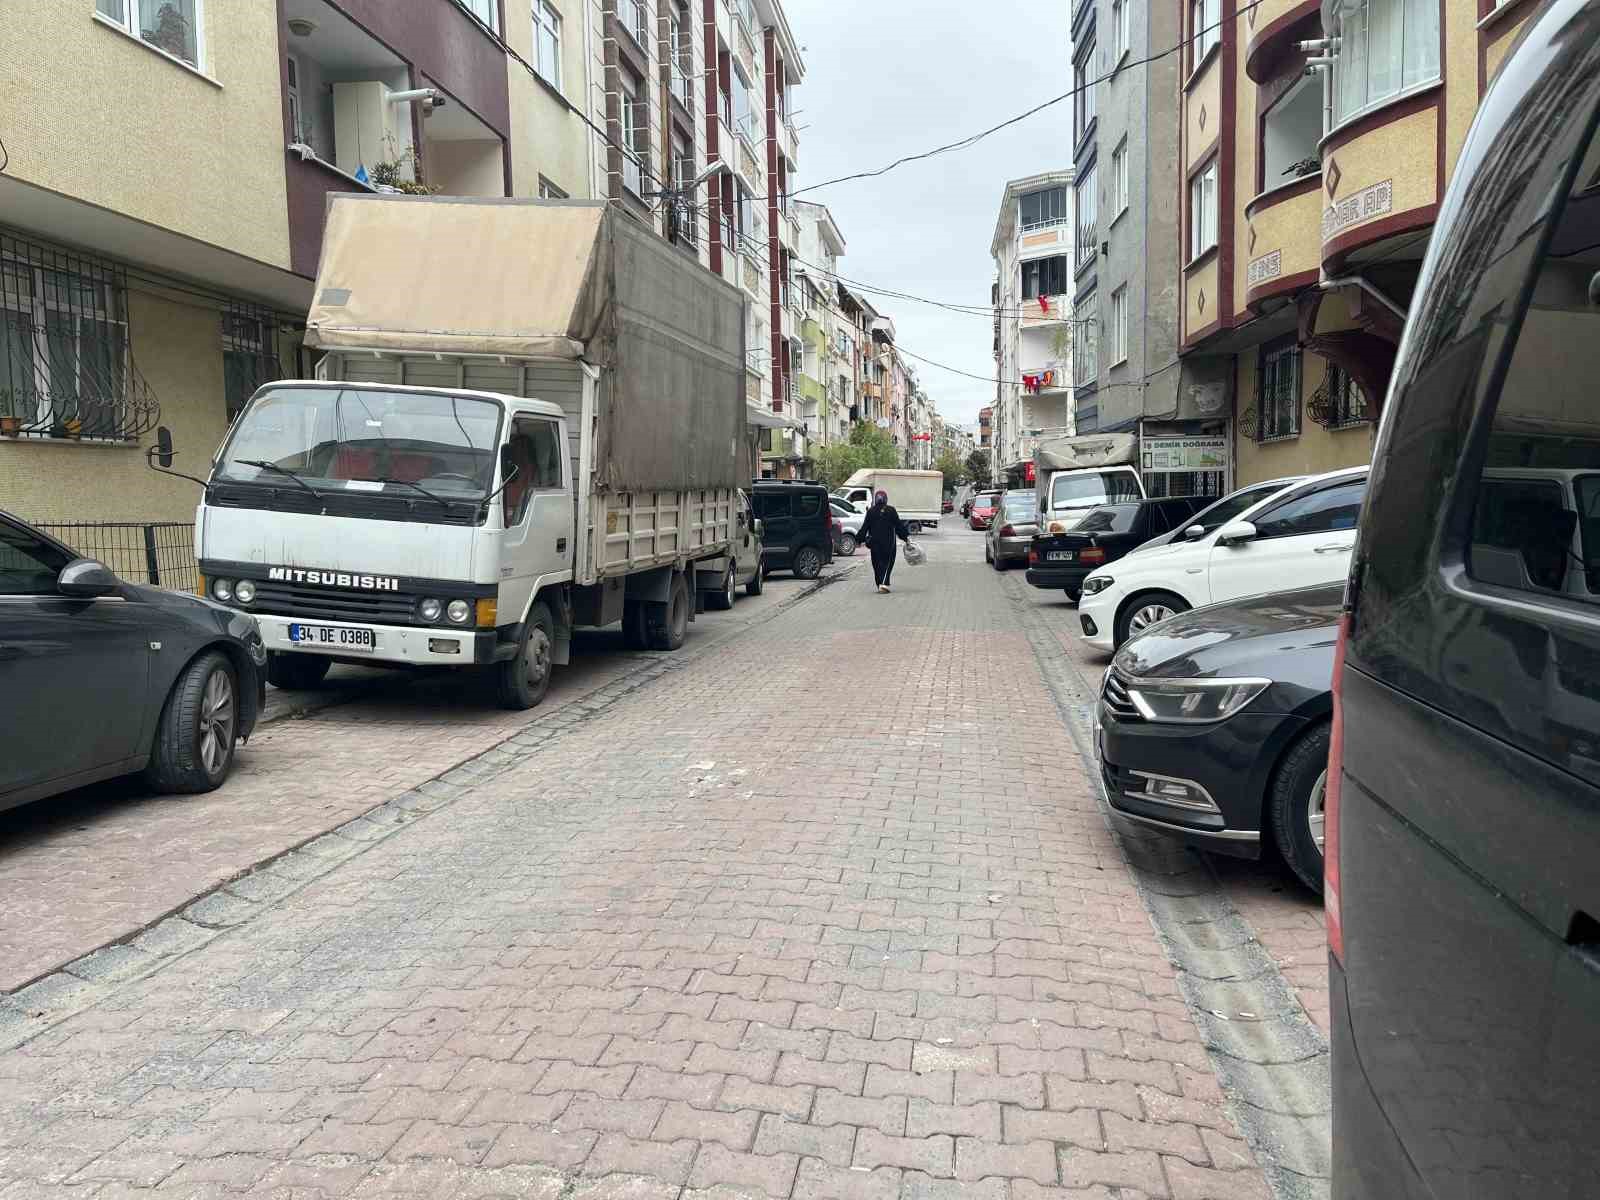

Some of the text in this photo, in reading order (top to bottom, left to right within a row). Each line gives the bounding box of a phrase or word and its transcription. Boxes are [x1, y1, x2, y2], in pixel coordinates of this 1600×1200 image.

[1183, 440, 1224, 448] DOĞRAMA
[269, 567, 399, 590] MITSUBISHI
[299, 627, 314, 641] 34
[320, 628, 335, 643] DE
[340, 630, 370, 645] 0388
